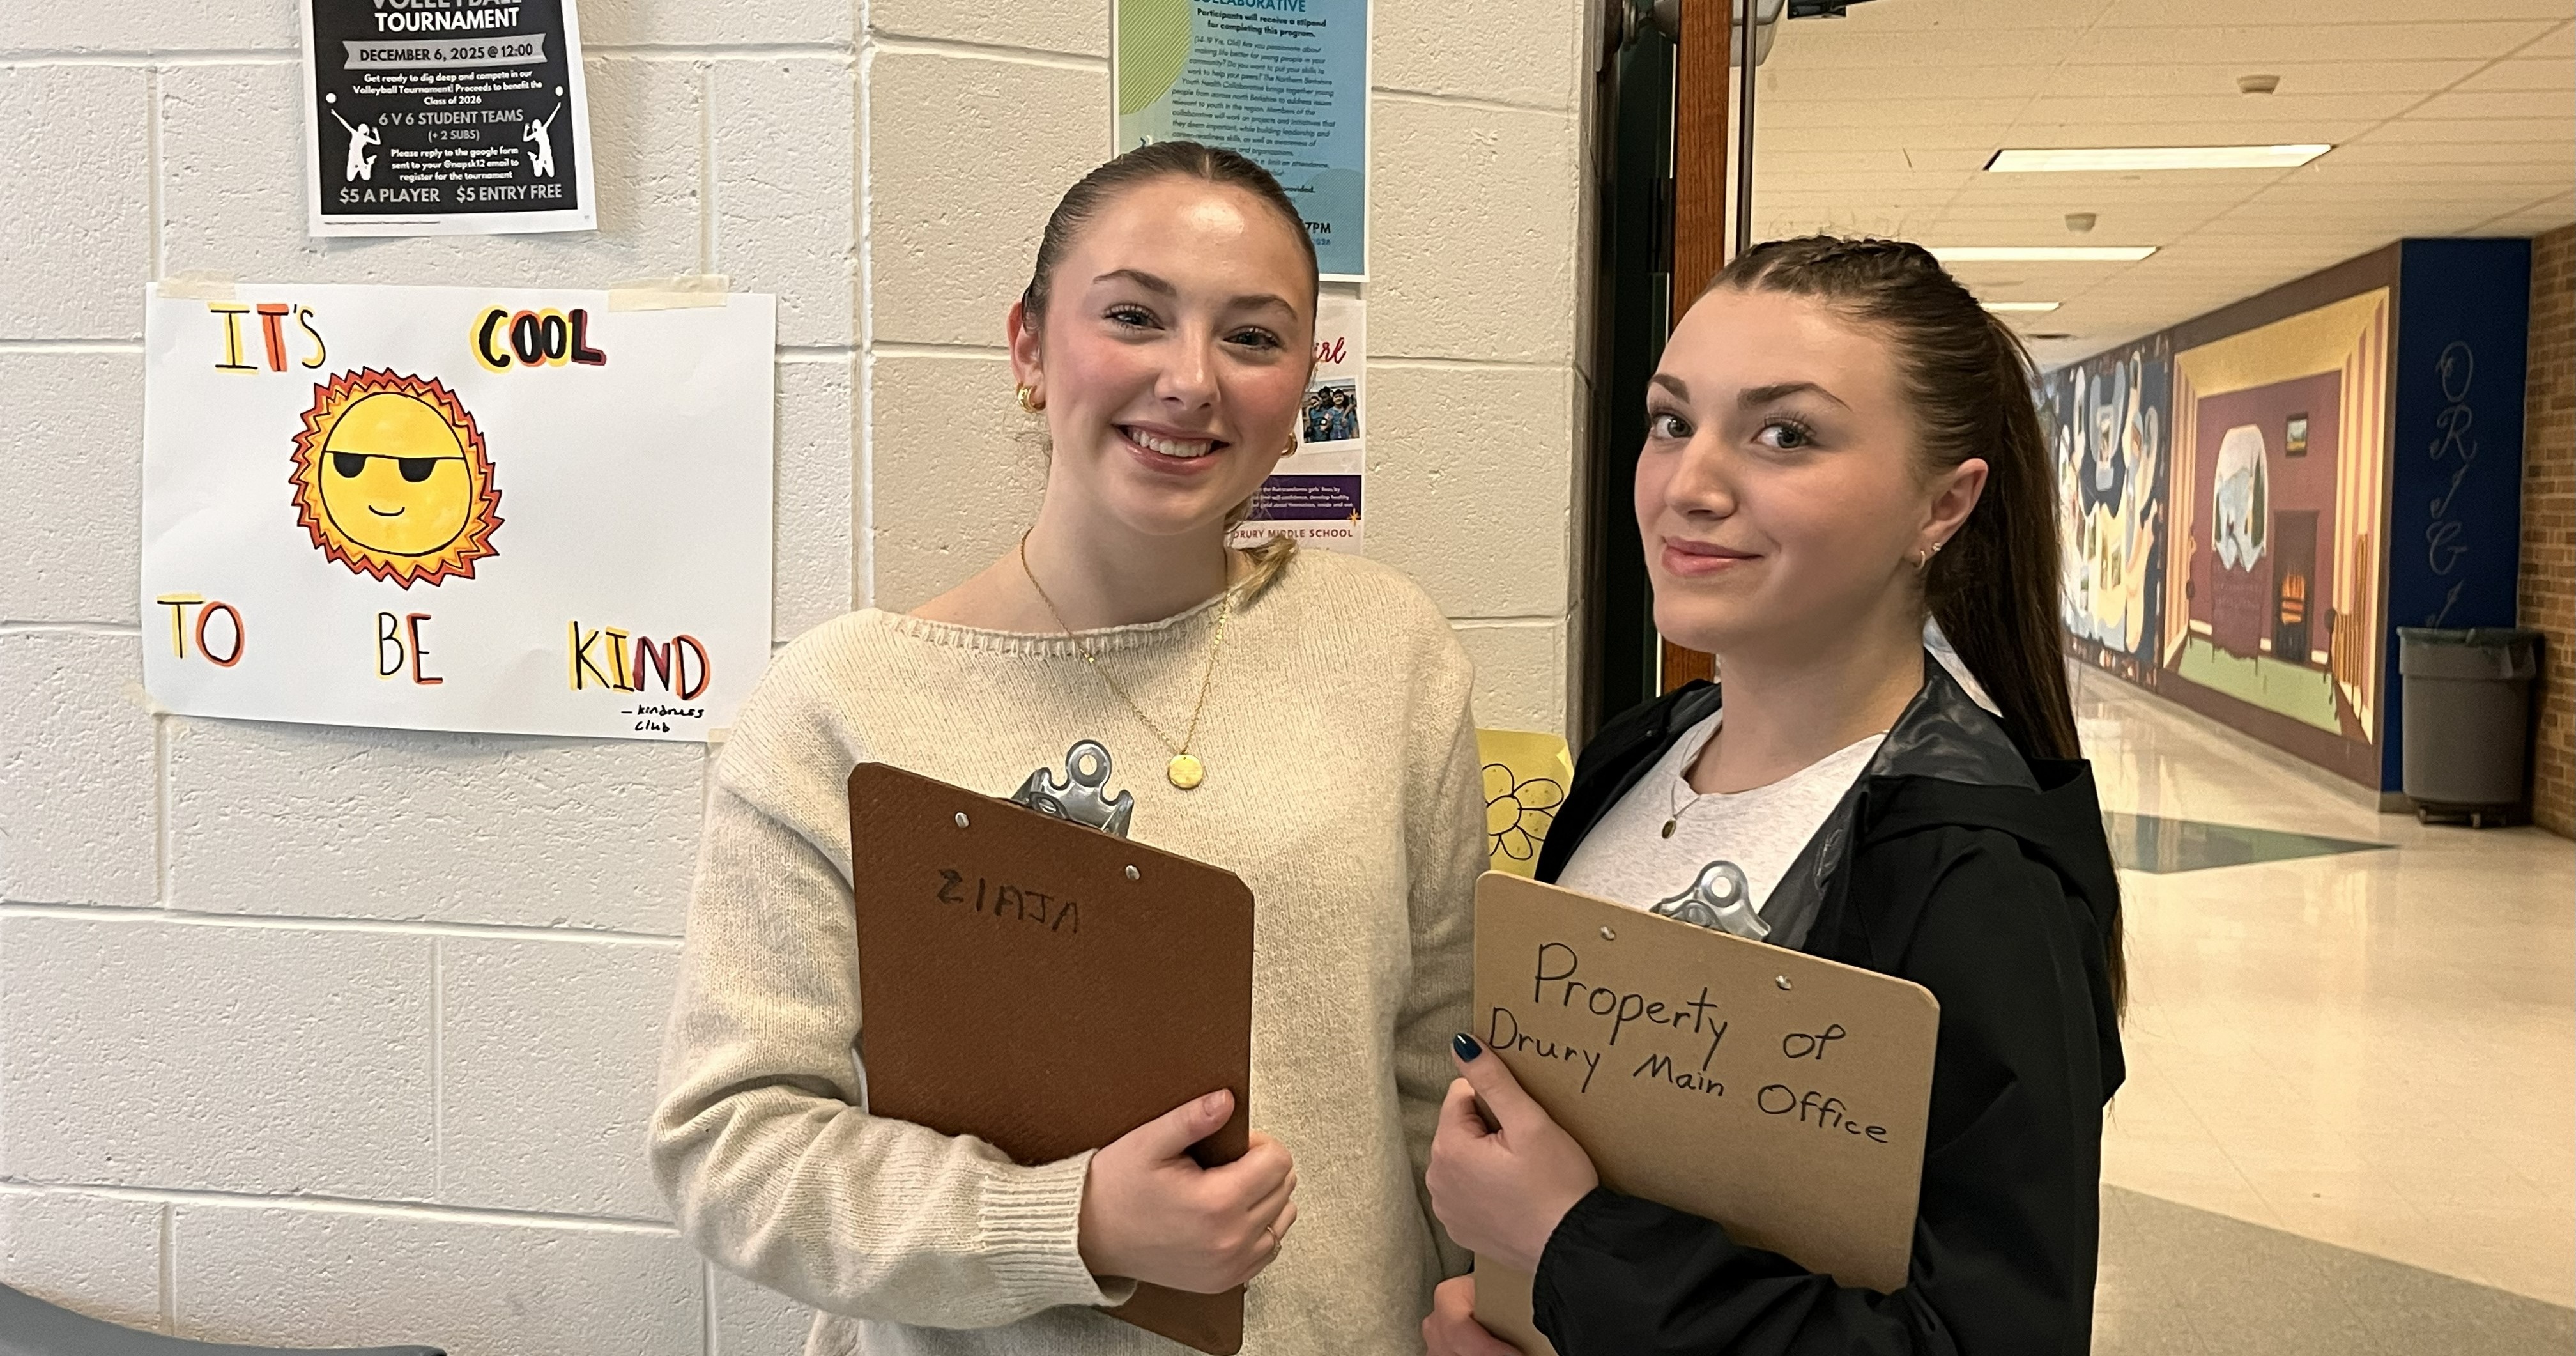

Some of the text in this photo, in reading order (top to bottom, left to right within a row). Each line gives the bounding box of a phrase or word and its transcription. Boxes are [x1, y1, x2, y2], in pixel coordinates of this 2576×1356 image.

[374, 7, 519, 32] TOURNAMENT
[1197, 8, 1243, 20] Participants
[1260, 15, 1287, 25] receive
[1296, 18, 1326, 29] stipend
[1208, 19, 1218, 28] for
[1220, 21, 1262, 35] completing
[1264, 26, 1278, 35] this
[360, 43, 533, 62] DECEMBER 6, 2025 @ 12:00
[364, 73, 380, 82] Get
[381, 73, 408, 84] ready
[420, 73, 434, 83] dig
[436, 72, 456, 83] deep
[458, 72, 474, 81] and
[476, 72, 509, 81] compete
[353, 85, 397, 96] Volleyball
[455, 83, 492, 93] Proceeds
[493, 82, 502, 91] to
[503, 81, 530, 90] benefit
[530, 81, 542, 89] the
[424, 95, 482, 105] Class of 2026
[379, 109, 523, 125] 6 V 6 STUDENT TEAMS
[440, 130, 448, 140] 2
[450, 129, 480, 142] SUBS)
[390, 148, 418, 157] Please
[420, 148, 443, 159] reply
[455, 147, 468, 156] the
[470, 146, 498, 157] google
[499, 146, 519, 155] form
[411, 161, 420, 169] to
[422, 162, 442, 171] your
[486, 158, 509, 167] email
[399, 170, 512, 183] register for the tournament
[339, 183, 563, 204] $5 A PLAYER $5 ENTRY FREE
[1305, 222, 1331, 234] 7PM
[208, 302, 608, 374] IT'S COOL
[1309, 528, 1353, 538] SCHOOL
[157, 594, 711, 700] TO BE KIND
[637, 704, 705, 719] kindness
[1534, 943, 1727, 1071] Property
[1489, 1007, 1889, 1144] Drury Main Office
